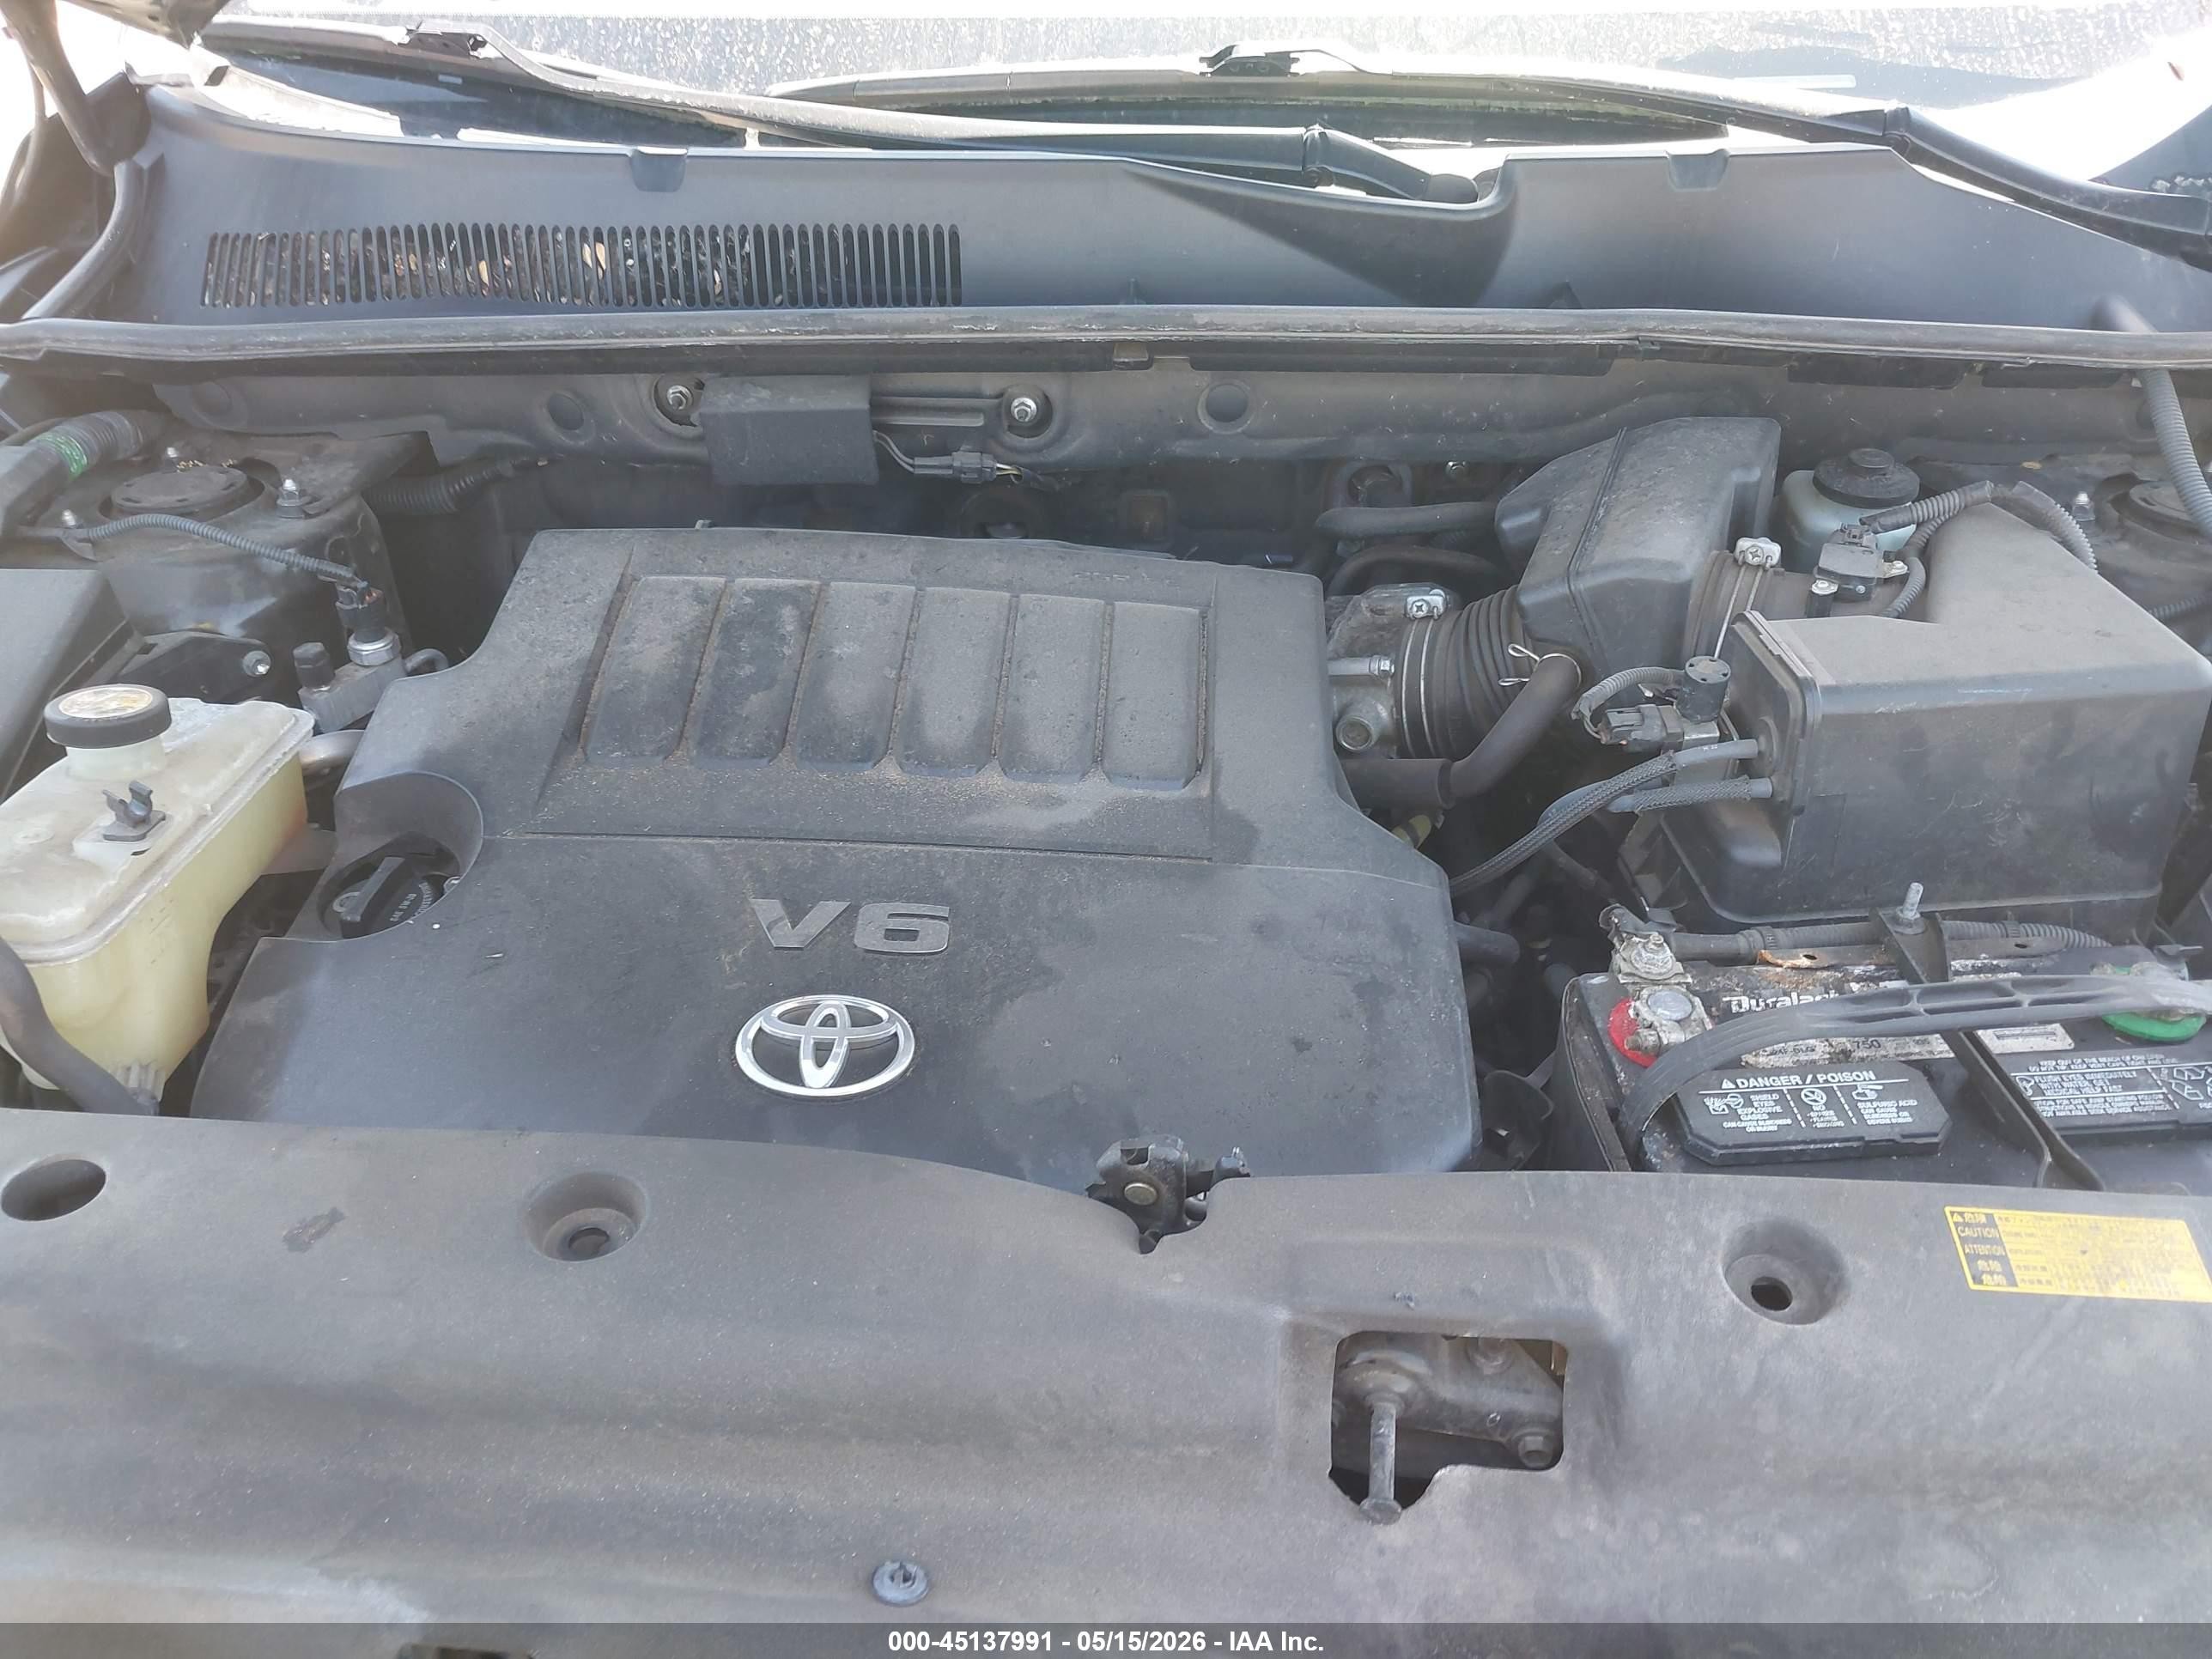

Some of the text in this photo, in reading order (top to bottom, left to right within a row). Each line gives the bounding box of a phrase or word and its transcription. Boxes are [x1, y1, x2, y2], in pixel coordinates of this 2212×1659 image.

[748, 898, 950, 953] V6
[1853, 1038, 1882, 1049] 750
[1736, 1075, 1802, 1088] DANGER
[1817, 1071, 1876, 1084] POISON
[1737, 1107, 1783, 1115] EXPLOSIVE
[1957, 1226, 2000, 1238] CAUTION
[1964, 1243, 2006, 1256] ATTENTION
